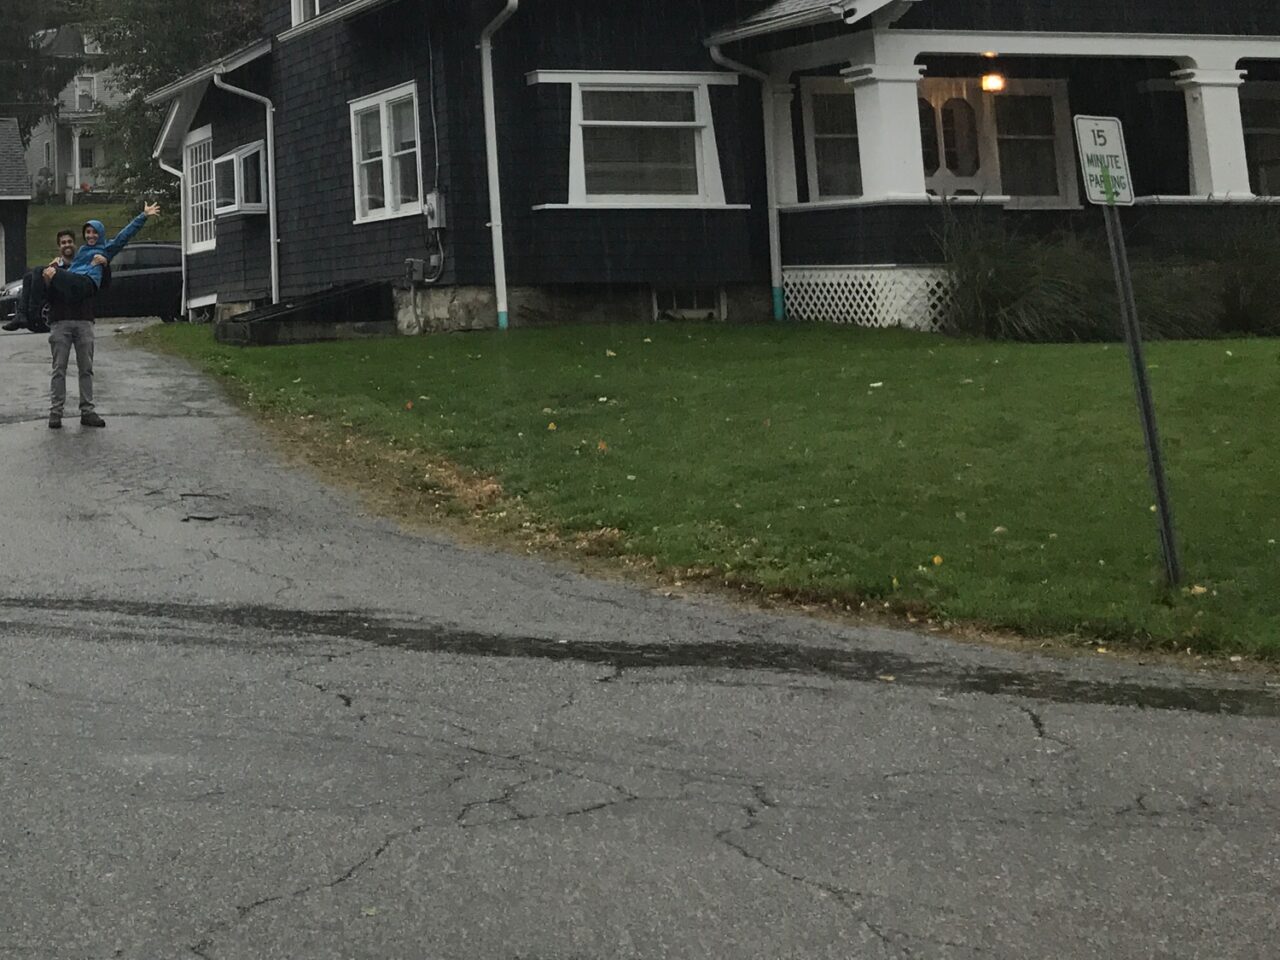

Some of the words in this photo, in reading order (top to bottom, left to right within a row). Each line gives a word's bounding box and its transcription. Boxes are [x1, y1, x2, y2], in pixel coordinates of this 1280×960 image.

[1091, 129, 1107, 147] 15
[1086, 153, 1122, 169] MINUTE
[1088, 174, 1127, 190] PARING
